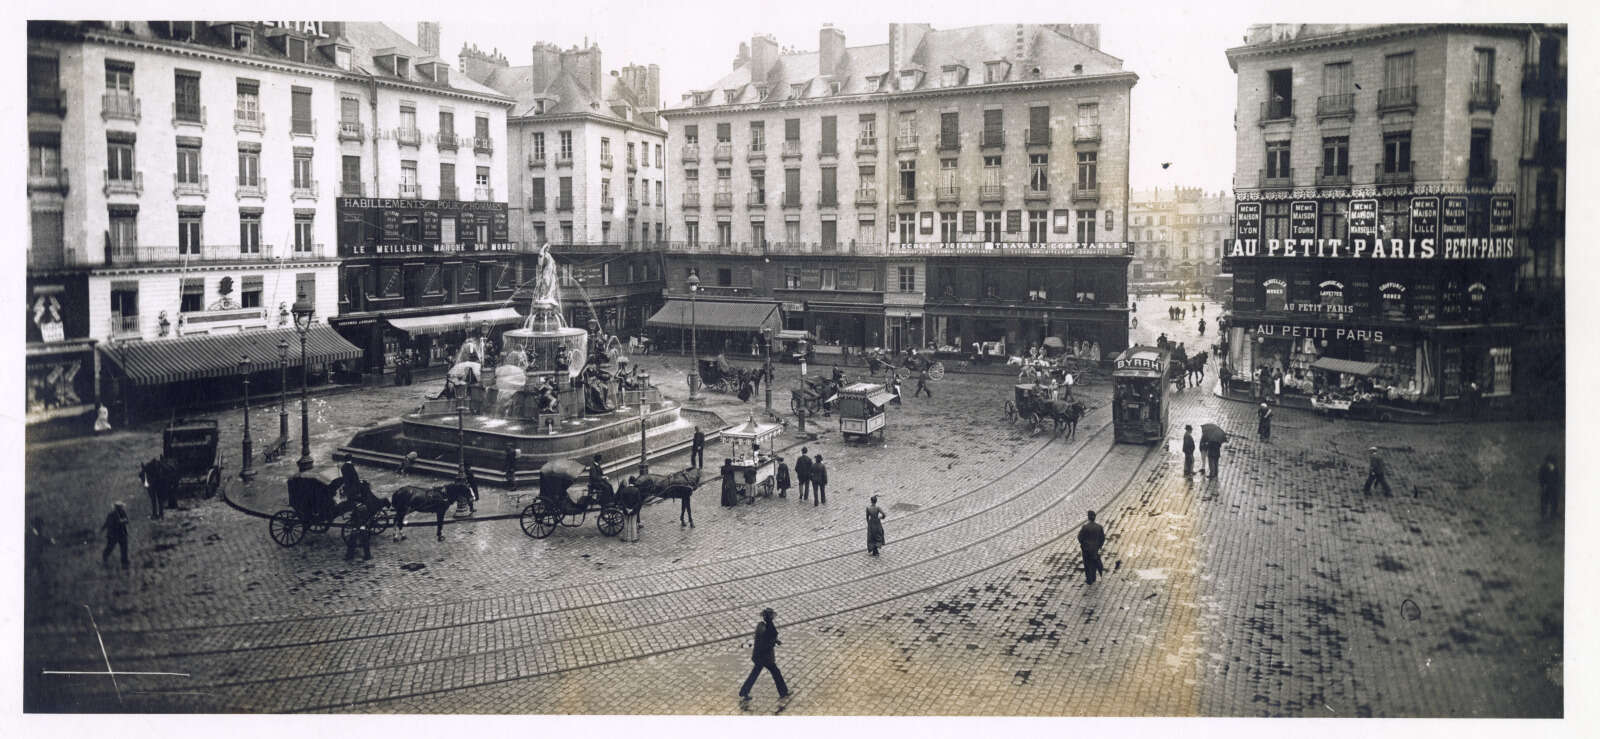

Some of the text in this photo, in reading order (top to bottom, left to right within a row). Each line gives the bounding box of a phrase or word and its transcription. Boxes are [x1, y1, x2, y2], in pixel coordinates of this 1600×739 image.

[344, 199, 425, 209] HABILLEMENTS
[1293, 212, 1315, 220] MAISON
[1412, 208, 1437, 217] MAISON
[1239, 226, 1258, 234] LYON
[1293, 225, 1315, 234] TOURS
[1414, 224, 1435, 233] LILLE
[353, 245, 365, 254] LE
[376, 244, 423, 254] MEILLEUR
[474, 243, 485, 251] DU
[491, 243, 517, 251] MONDE
[1231, 238, 1257, 257] AU
[1283, 303, 1354, 313] AU PETIT PARIS
[1256, 324, 1383, 342] AU PETIT PARIS
[1117, 359, 1159, 371] BYRRH
